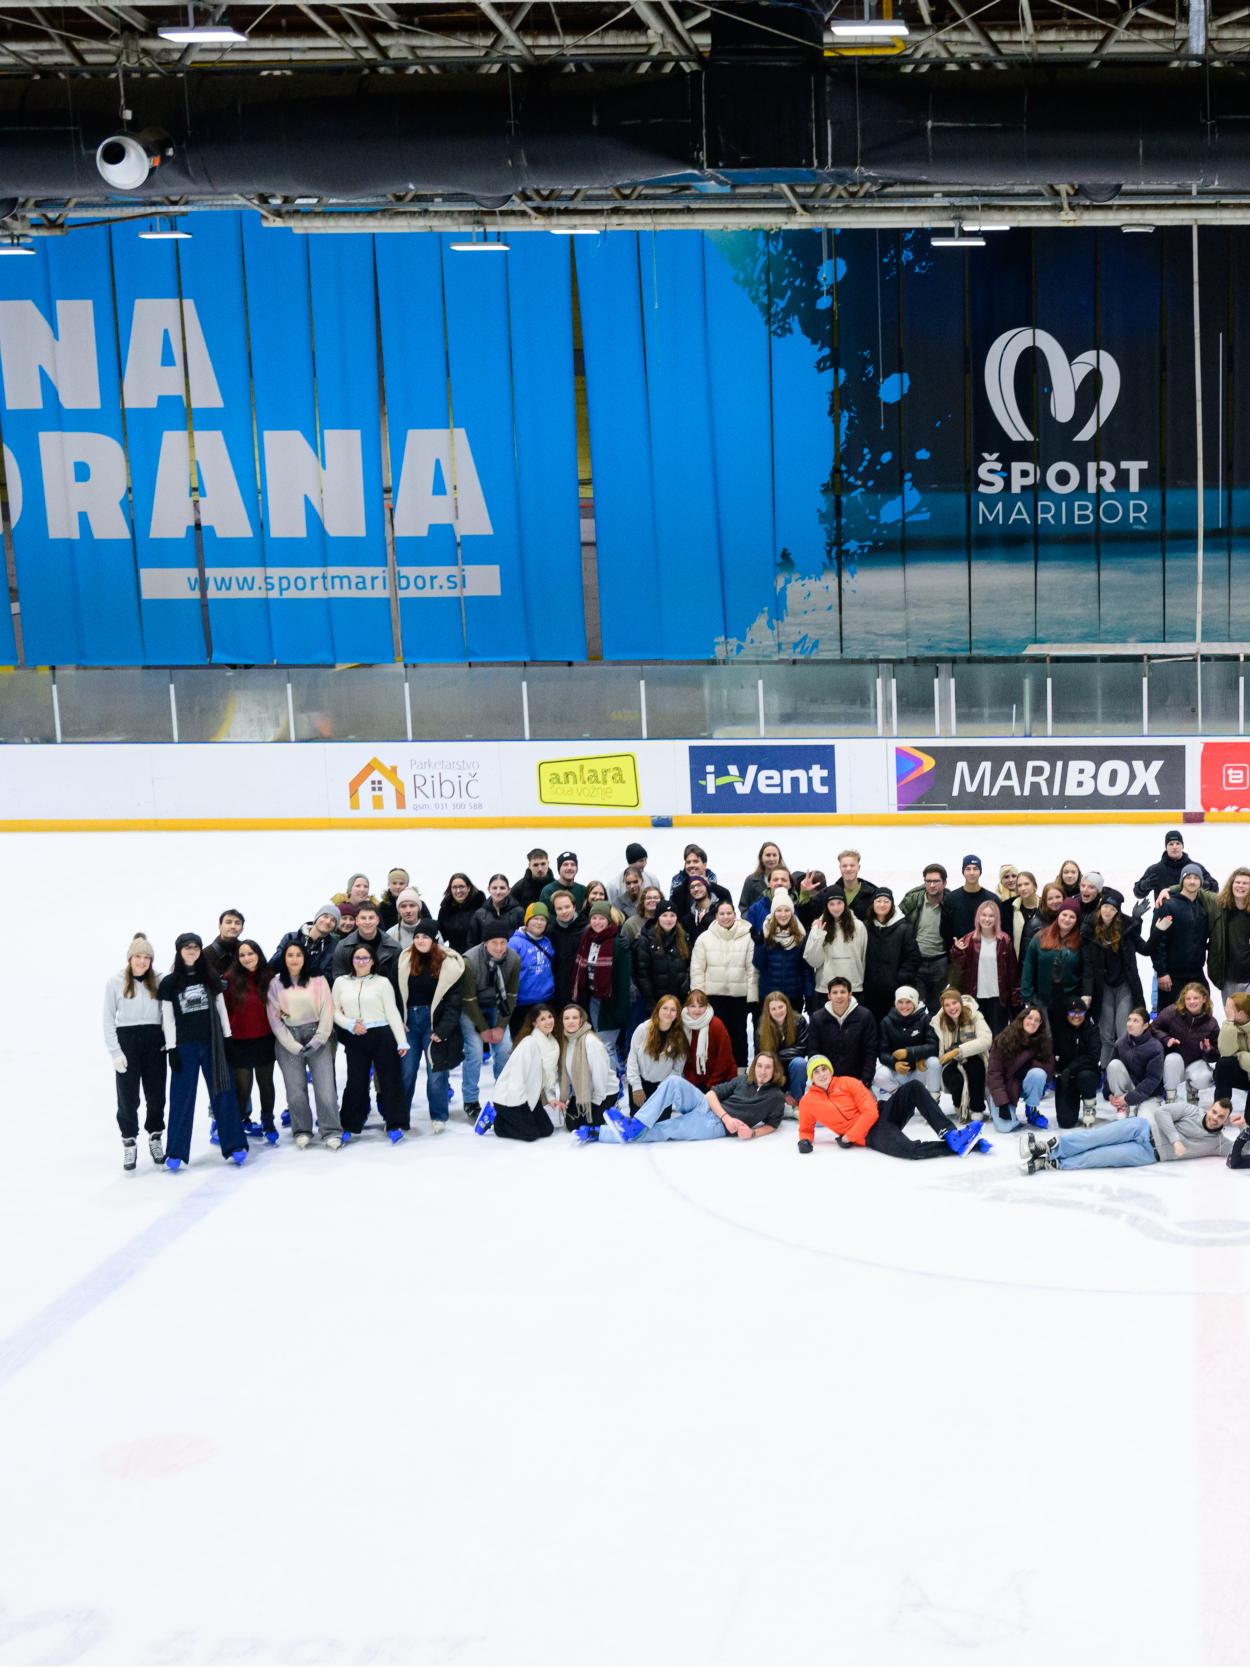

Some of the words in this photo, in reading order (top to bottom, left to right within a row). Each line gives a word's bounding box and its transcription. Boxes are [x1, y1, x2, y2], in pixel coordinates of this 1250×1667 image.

[977, 452, 1149, 494] ŠPORT
[977, 500, 1149, 525] MARIBOR
[187, 568, 468, 597] www.sportmaribor.si
[412, 771, 480, 800] Ribič
[548, 764, 626, 785] anlara
[951, 760, 1165, 797] MARIBOX
